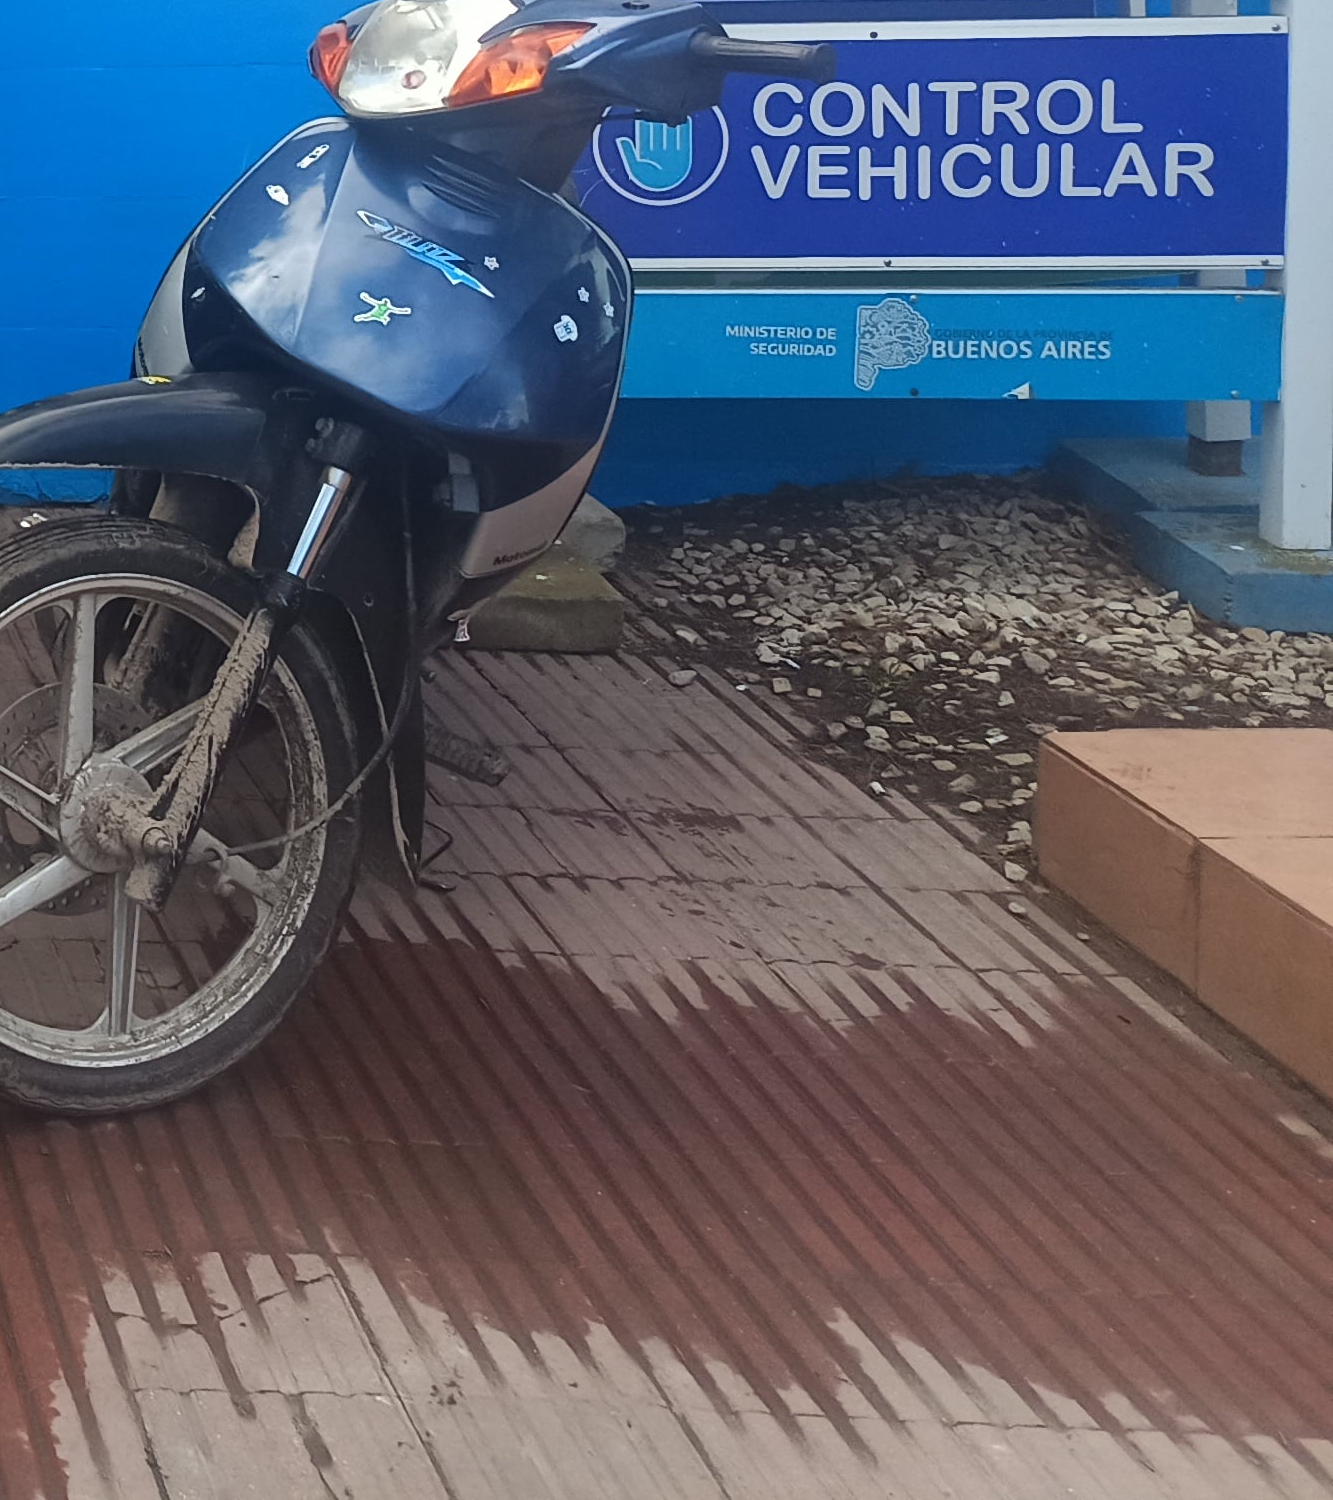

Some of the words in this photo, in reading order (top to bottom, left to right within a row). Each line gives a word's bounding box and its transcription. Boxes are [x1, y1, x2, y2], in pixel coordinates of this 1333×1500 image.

[752, 78, 1144, 139] CONTROL
[750, 142, 1215, 201] VEHICULAR
[725, 325, 813, 339] MINISTERIO
[816, 327, 837, 340] DE
[749, 342, 837, 357] SEGURIDAD
[931, 339, 1033, 359] BUENOS
[1039, 340, 1112, 360] AIRES
